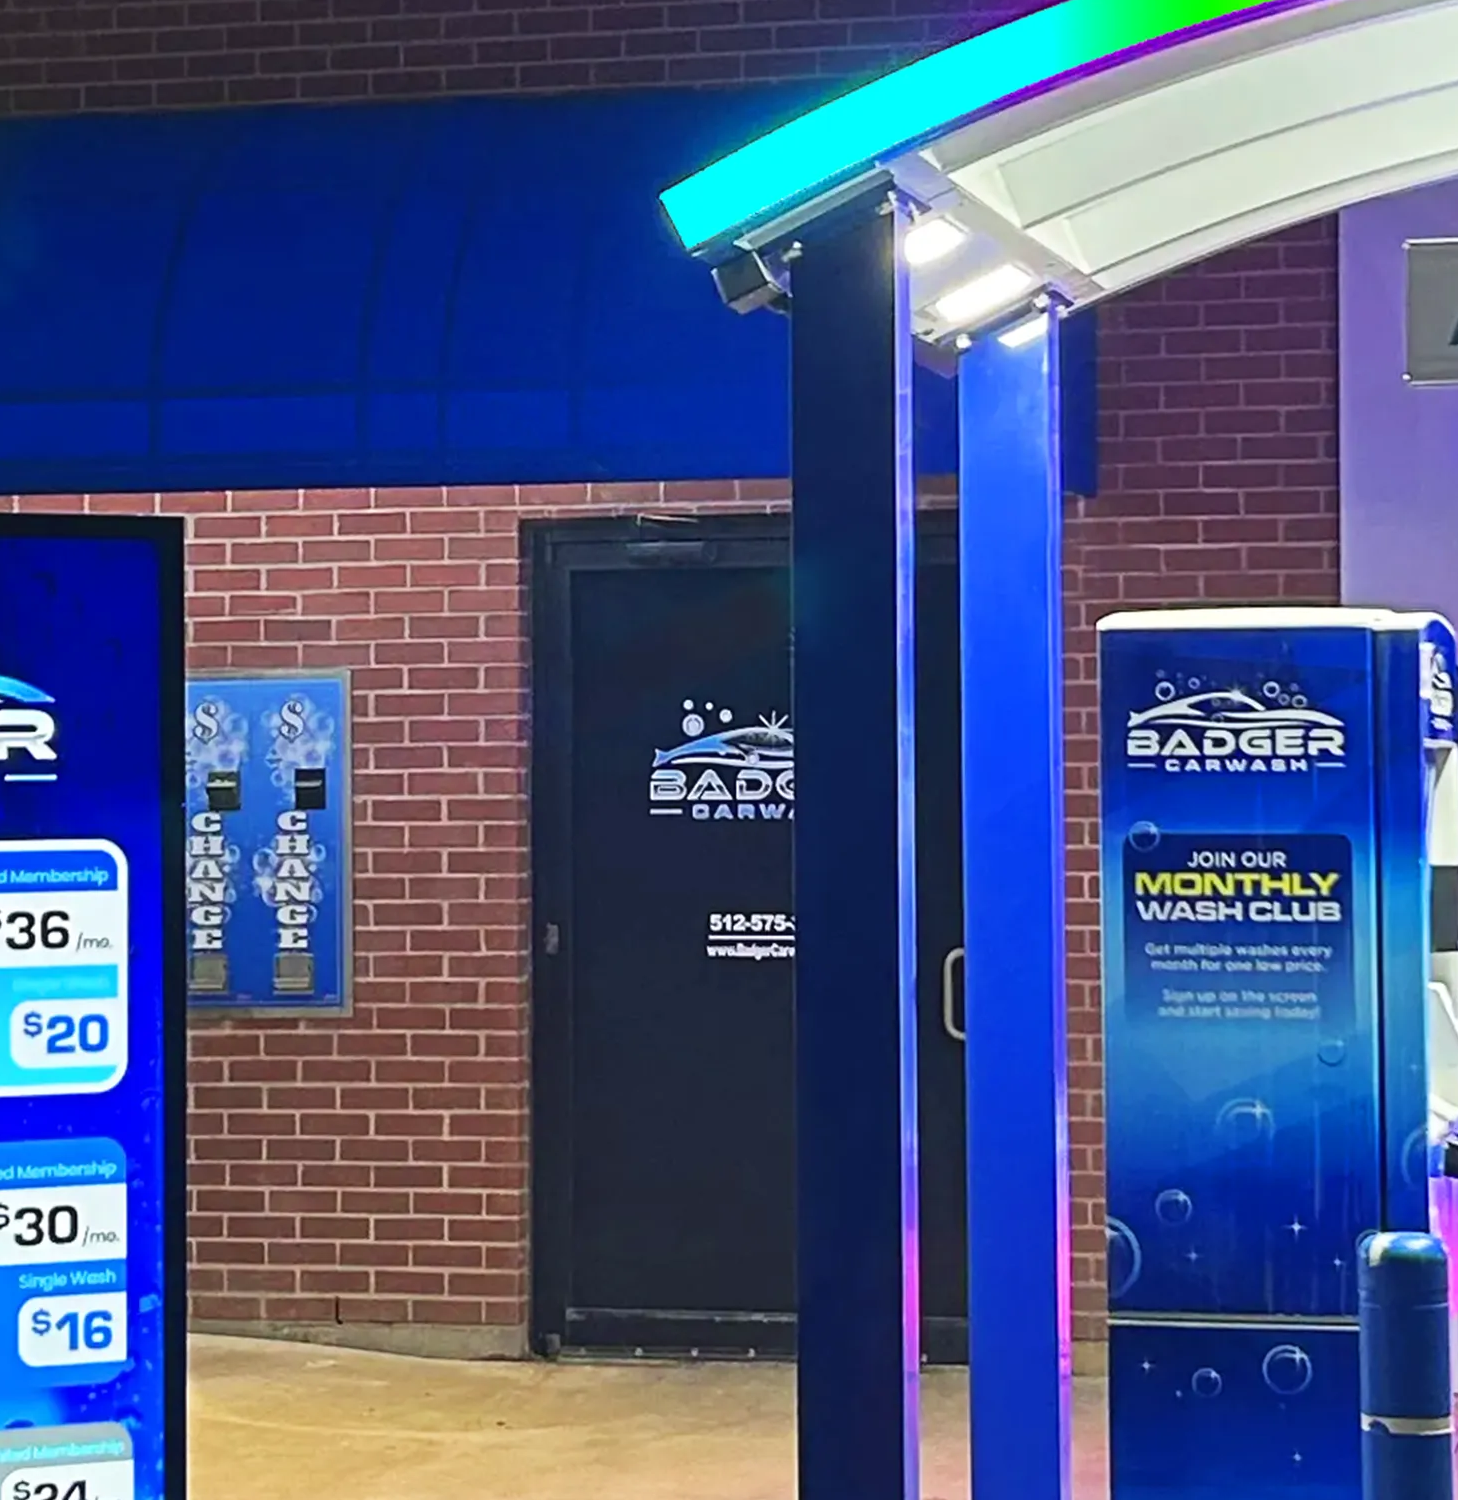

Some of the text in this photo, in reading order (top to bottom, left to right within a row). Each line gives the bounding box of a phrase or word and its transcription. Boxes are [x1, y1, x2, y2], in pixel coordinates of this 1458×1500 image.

[193, 701, 220, 745] $
[278, 700, 305, 745] $
[1126, 729, 1346, 757] BADGER
[1164, 757, 1309, 772] CARWASH
[691, 803, 795, 820] CARW
[1187, 850, 1287, 868] JOIN OUR
[10, 866, 109, 887] Membership
[188, 810, 226, 951] CHANGE
[275, 809, 312, 950] CHANGE
[1134, 871, 1340, 897] MONTHLY
[1135, 899, 1342, 923] WASH CLUB
[1144, 942, 1333, 959] Get multiple washes every
[1150, 958, 1198, 971] month
[1200, 958, 1221, 971] for
[1224, 960, 1253, 972] one
[1255, 959, 1282, 972] low
[1241, 988, 1265, 1003] the
[23, 1011, 110, 1054] $20
[16, 1160, 117, 1179] Membership
[18, 1269, 116, 1291] Single Wash
[31, 1308, 113, 1352] $16
